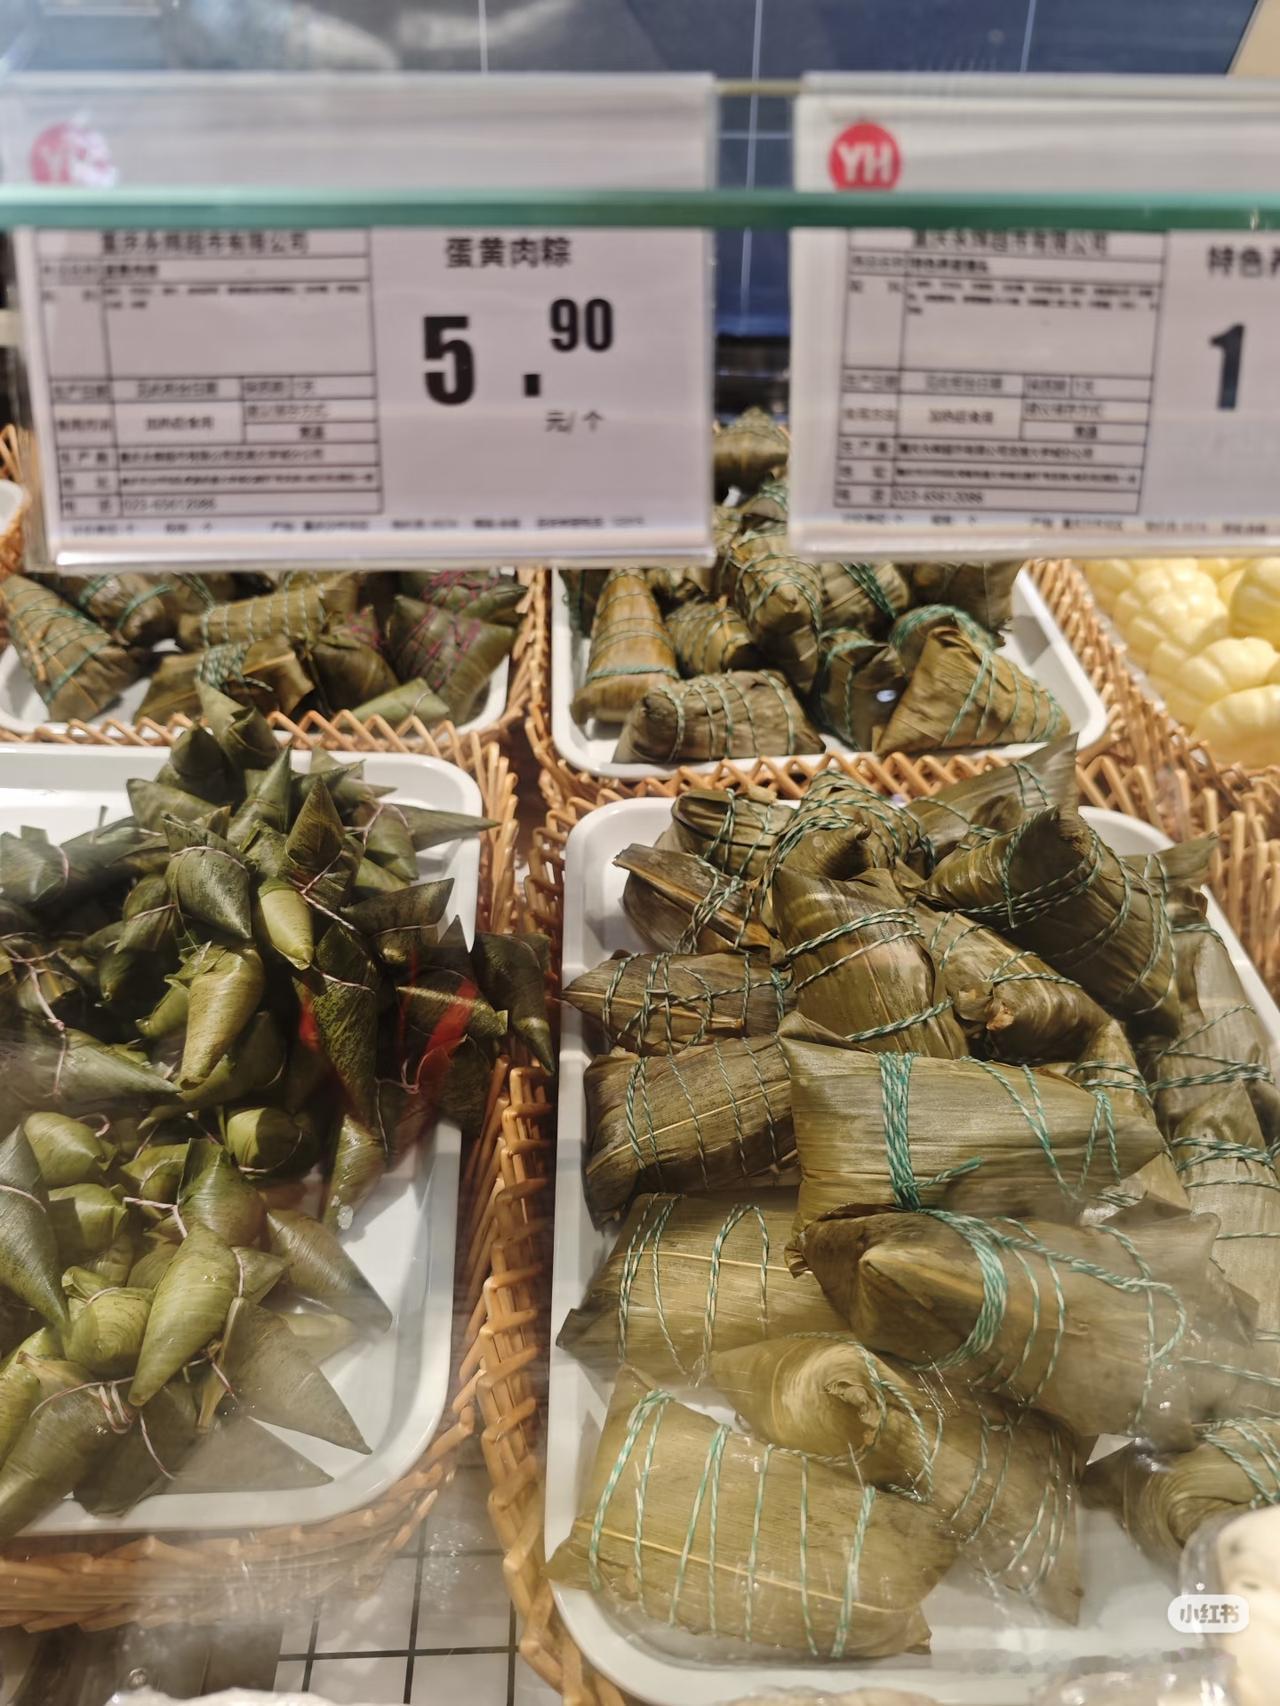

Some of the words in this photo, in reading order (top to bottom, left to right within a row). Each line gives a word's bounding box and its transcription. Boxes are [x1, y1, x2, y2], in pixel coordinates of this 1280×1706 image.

[837, 140, 893, 185] YH
[445, 236, 572, 270] 蛋黄肉粽
[1208, 321, 1247, 413] 1
